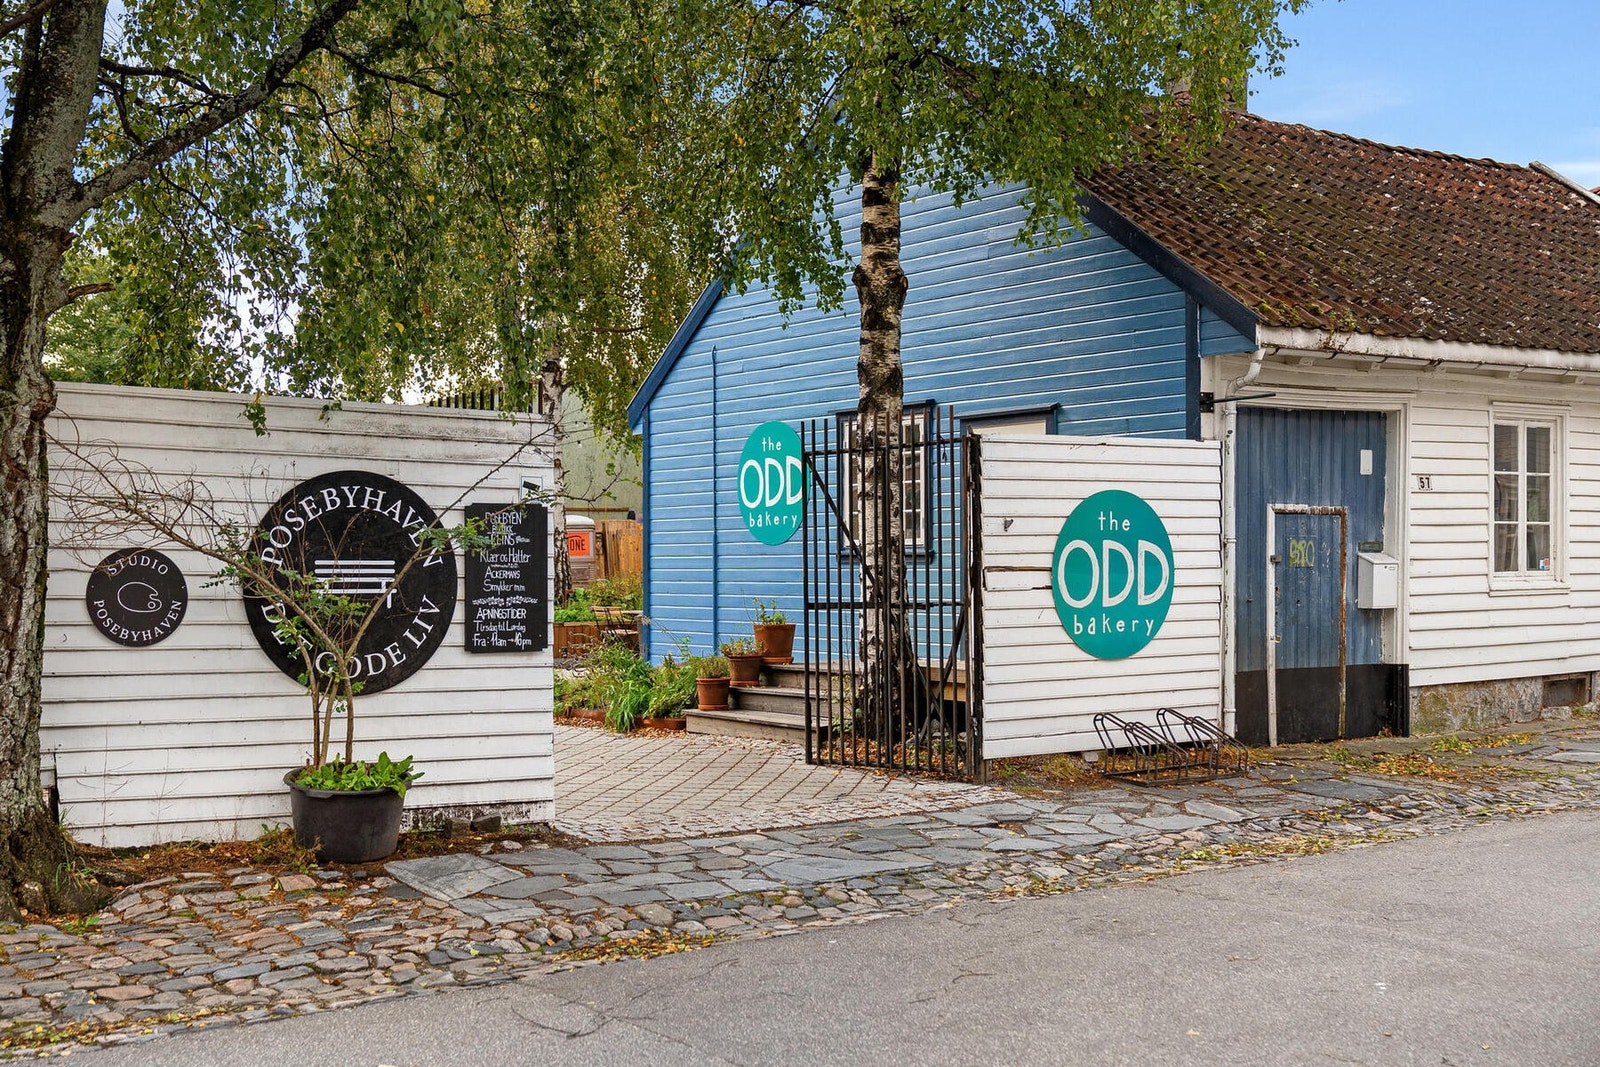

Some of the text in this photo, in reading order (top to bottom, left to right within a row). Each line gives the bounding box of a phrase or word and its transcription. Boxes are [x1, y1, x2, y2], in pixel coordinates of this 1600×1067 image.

[761, 436, 782, 452] the
[740, 455, 803, 509] ODD
[749, 512, 797, 528] bakery
[1098, 511, 1131, 531] the
[107, 555, 169, 575] STUDIO
[1057, 539, 1170, 608] ODD
[94, 600, 182, 642] POSEBYHAVEN
[403, 594, 443, 650] LIV
[1073, 613, 1154, 636] bakery
